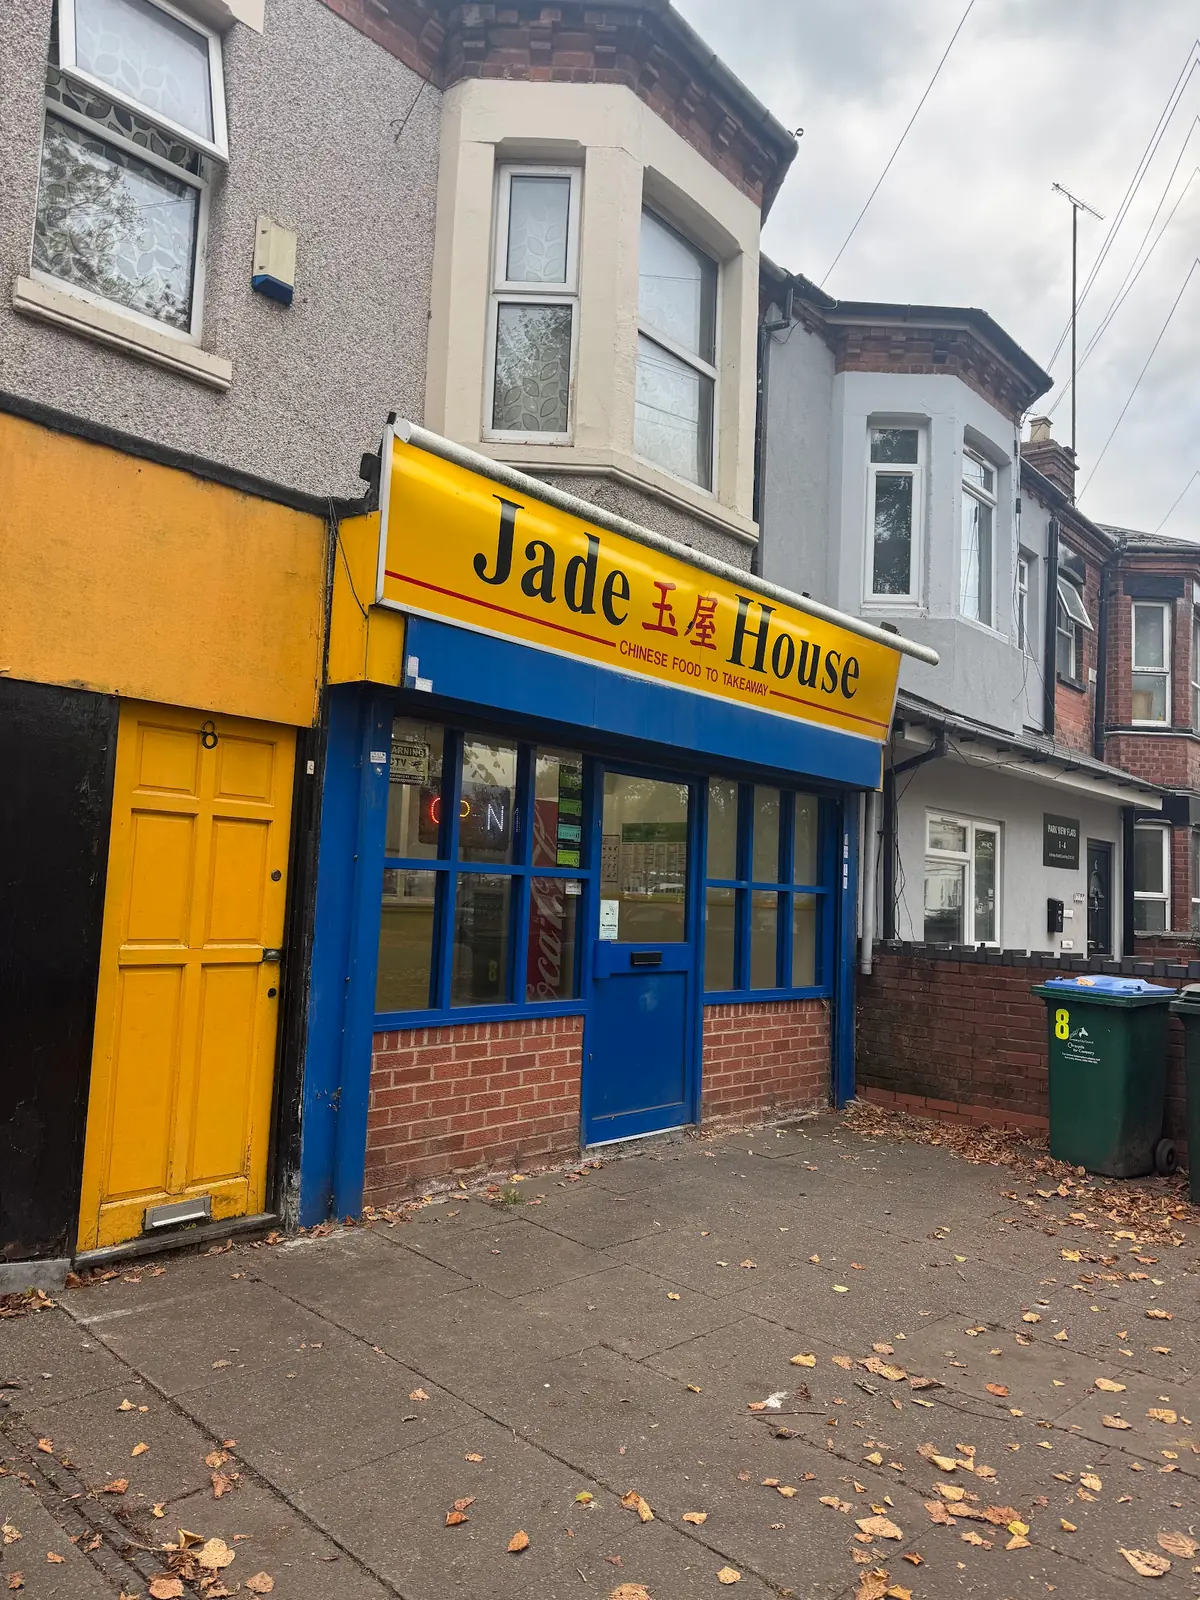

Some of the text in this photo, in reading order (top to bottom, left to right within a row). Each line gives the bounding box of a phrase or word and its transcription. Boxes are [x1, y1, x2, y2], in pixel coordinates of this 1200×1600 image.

[473, 494, 630, 626] Jade
[641, 581, 719, 651] 玉屋
[726, 593, 860, 699] House
[619, 640, 769, 697] CHINESE FOOD TO TAKEAWAY
[201, 720, 218, 749] 8
[392, 745, 424, 757] ARNING
[390, 757, 406, 767] CTV
[1055, 1008, 1070, 1040] 8
